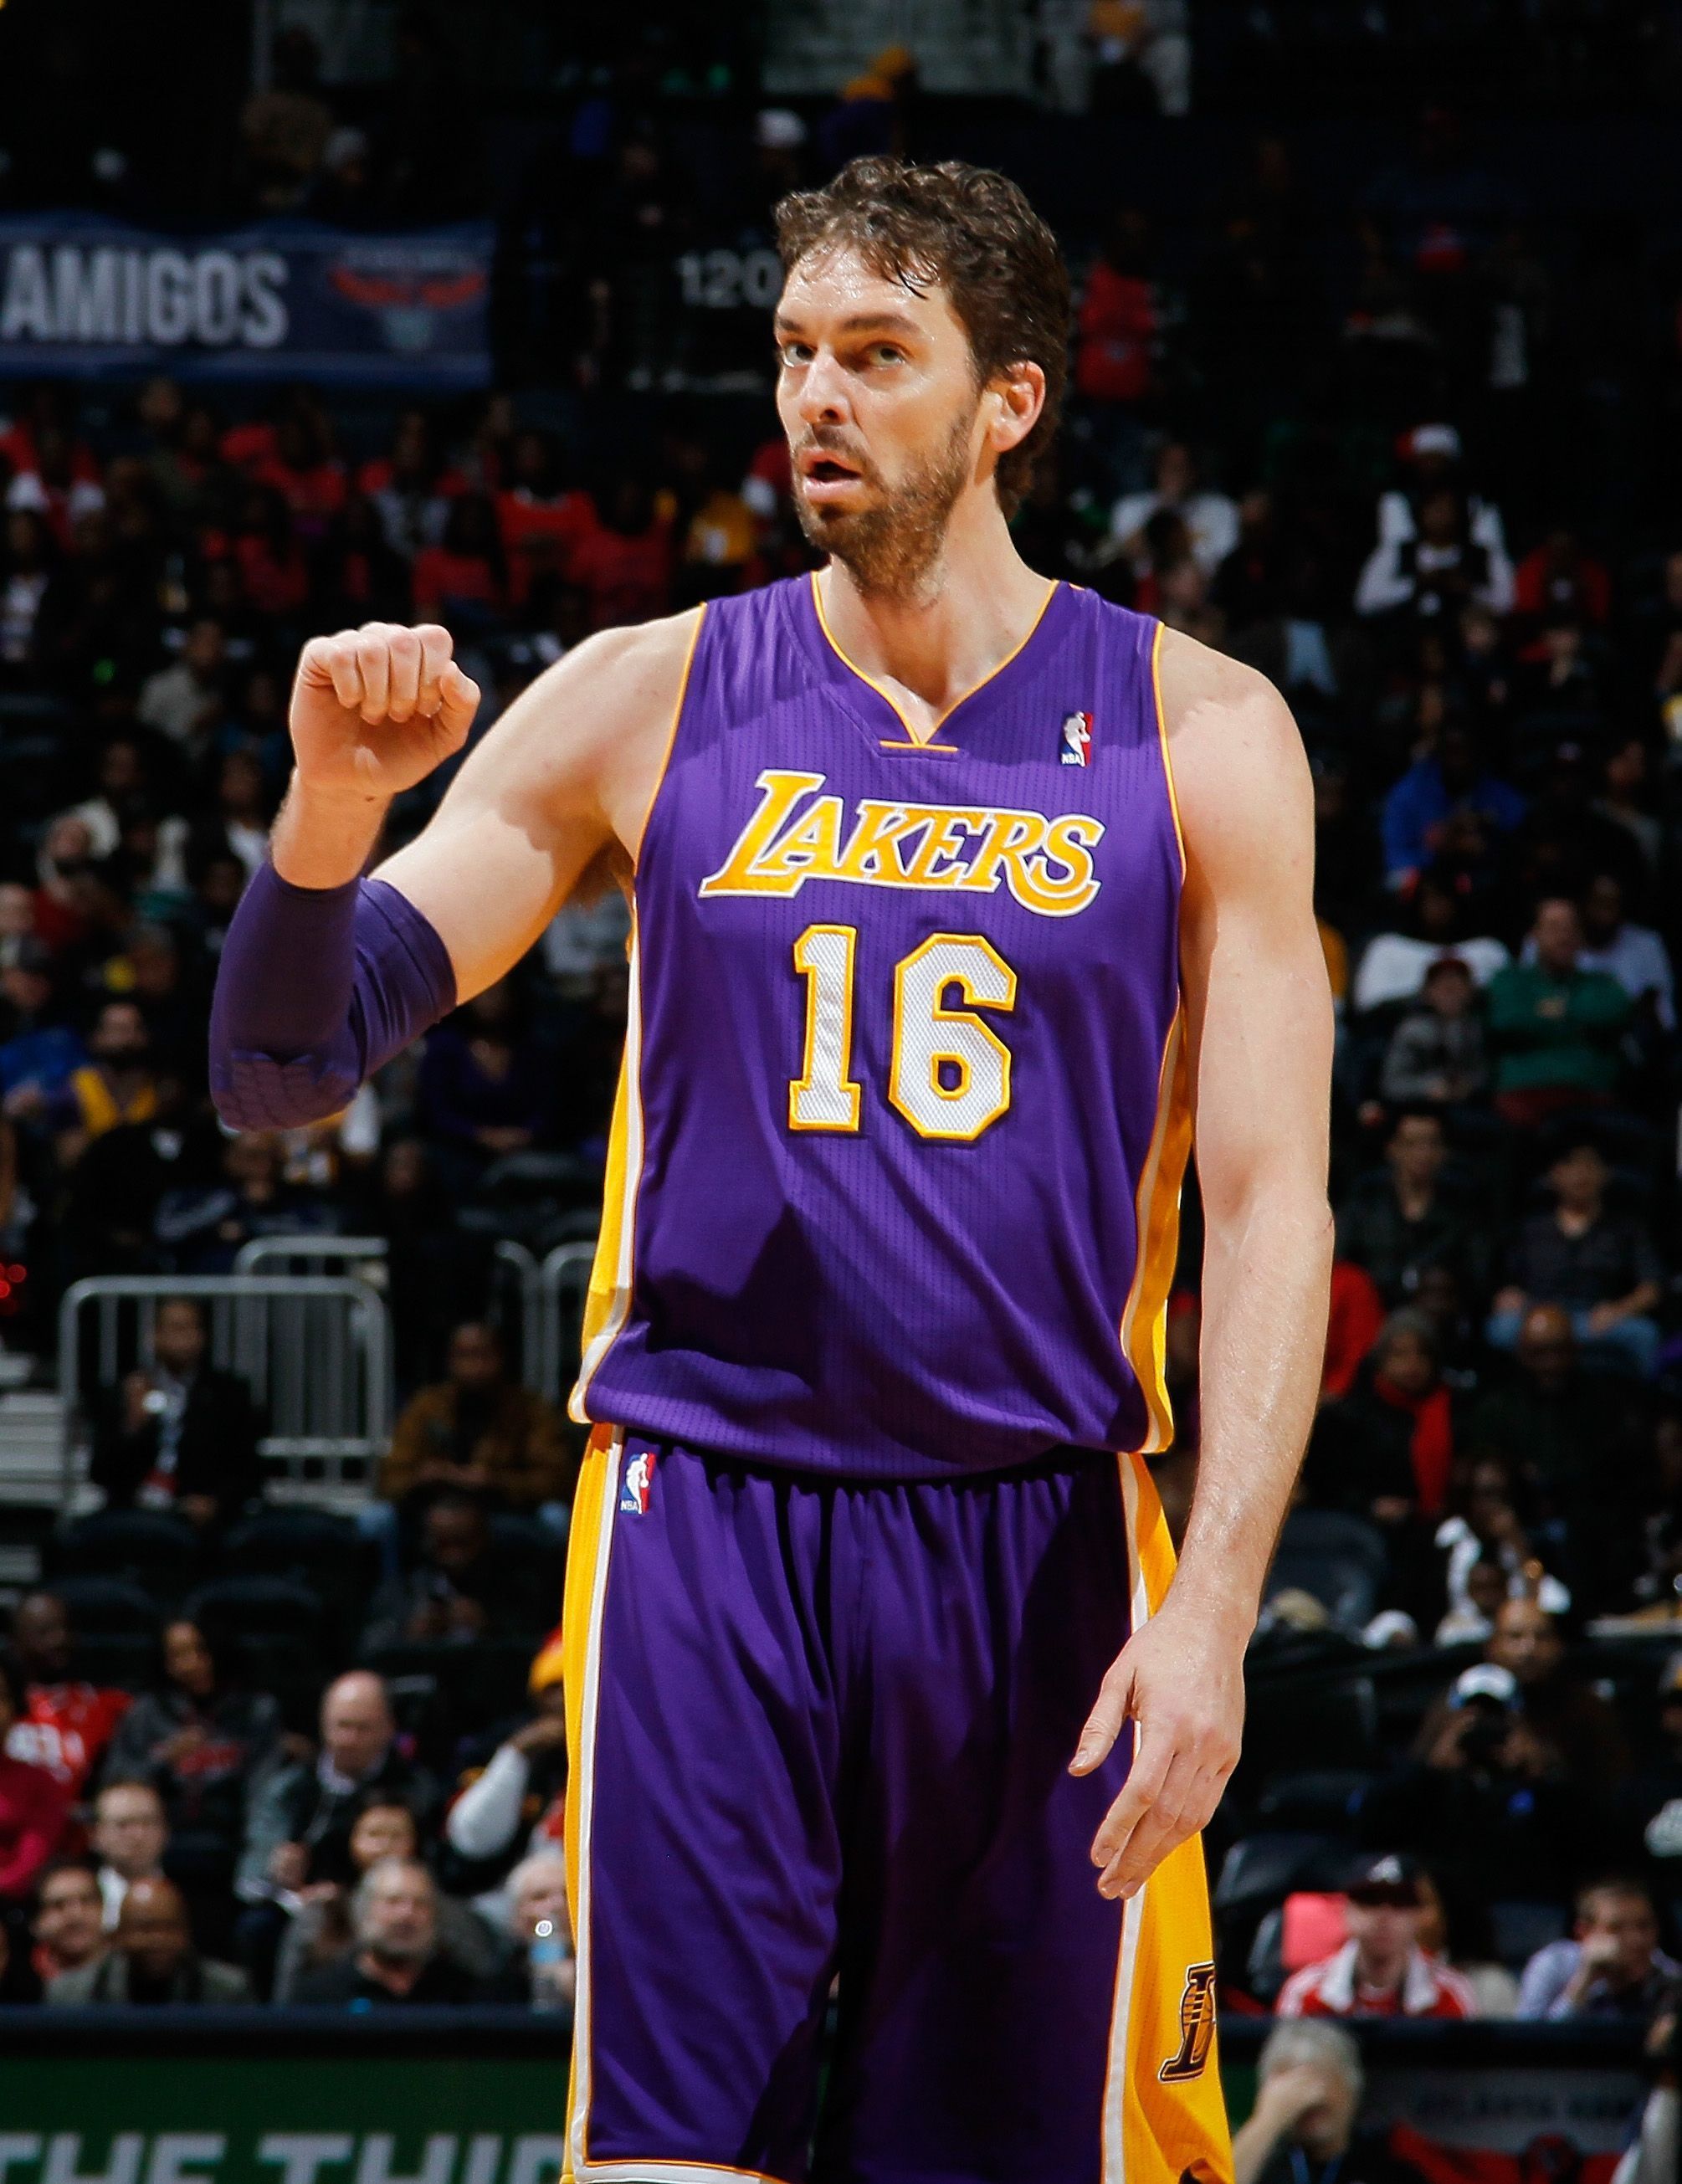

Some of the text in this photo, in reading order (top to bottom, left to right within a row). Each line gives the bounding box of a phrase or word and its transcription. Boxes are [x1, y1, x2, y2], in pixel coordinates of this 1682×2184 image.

[2, 245, 290, 347] AMIGOS
[675, 249, 785, 309] 120
[698, 769, 1106, 918] LAKERS
[788, 923, 1018, 1142] 16
[0, 2129, 566, 2184] HE THI
